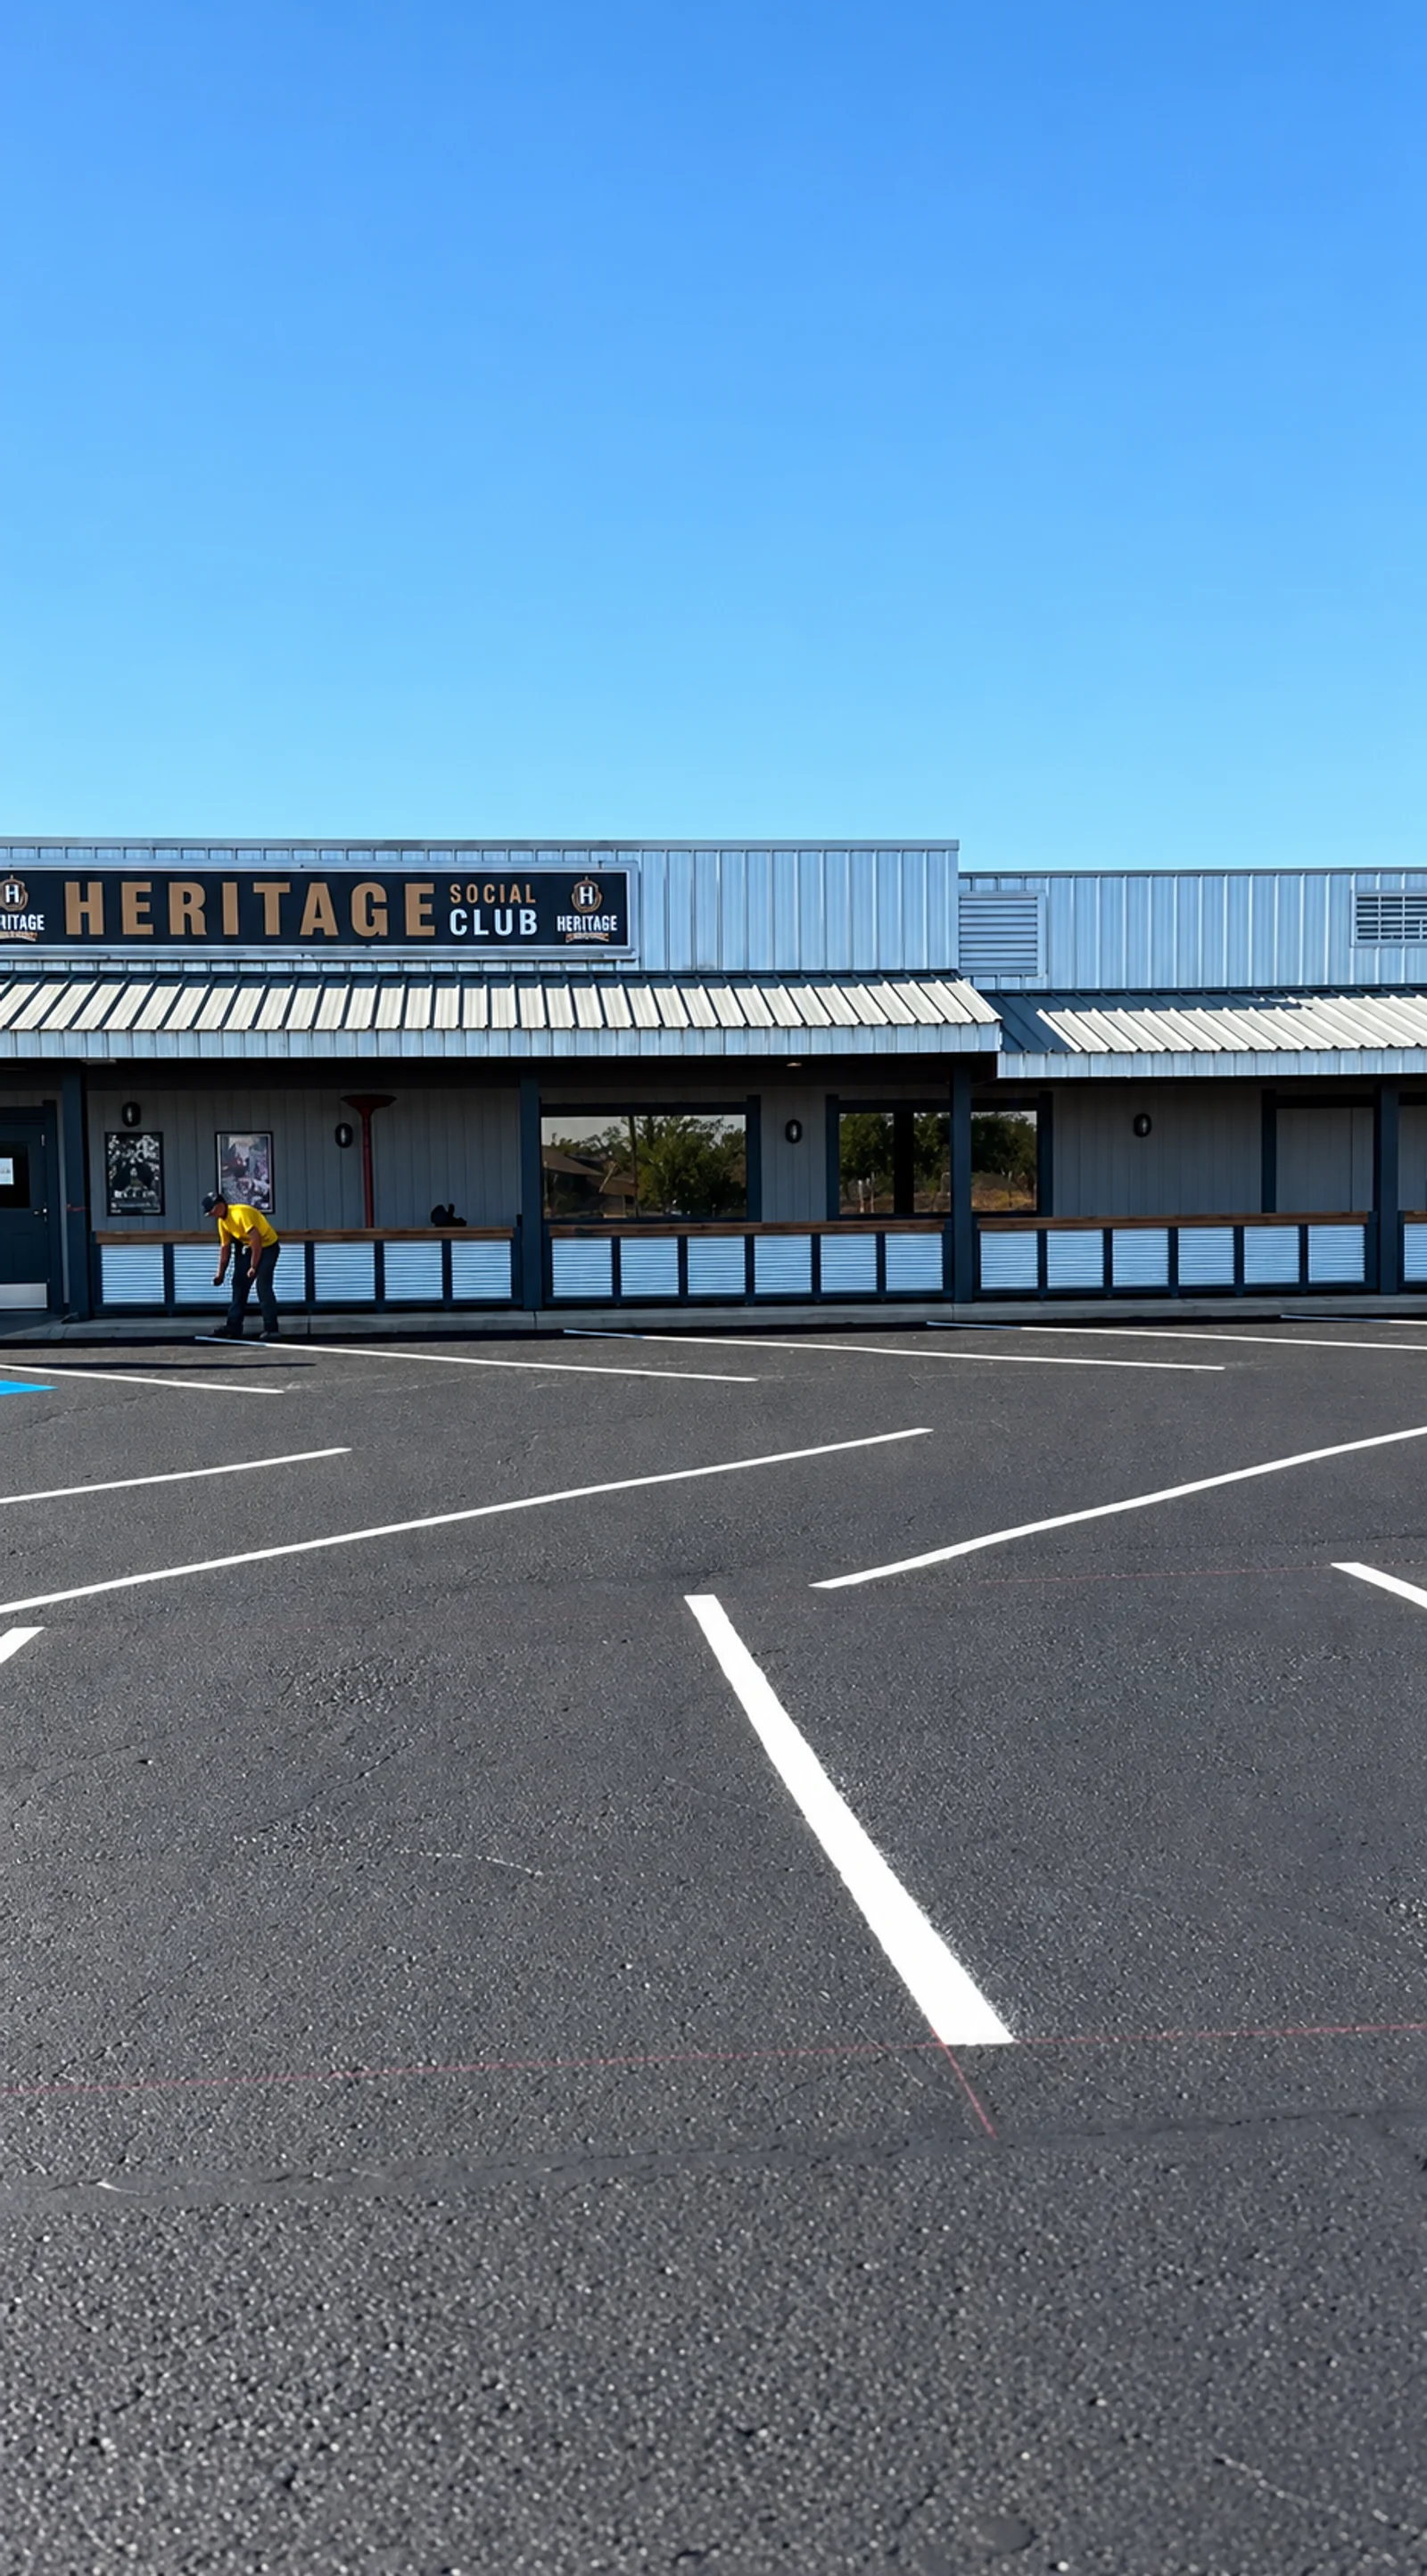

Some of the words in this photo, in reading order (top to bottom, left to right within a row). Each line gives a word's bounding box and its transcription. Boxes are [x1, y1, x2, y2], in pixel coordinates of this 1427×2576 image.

[450, 883, 536, 904] SOCIAL
[580, 887, 593, 904] H
[64, 881, 435, 937] HERITAGE
[450, 908, 538, 936] CLUB
[557, 915, 617, 931] HERITAGE
